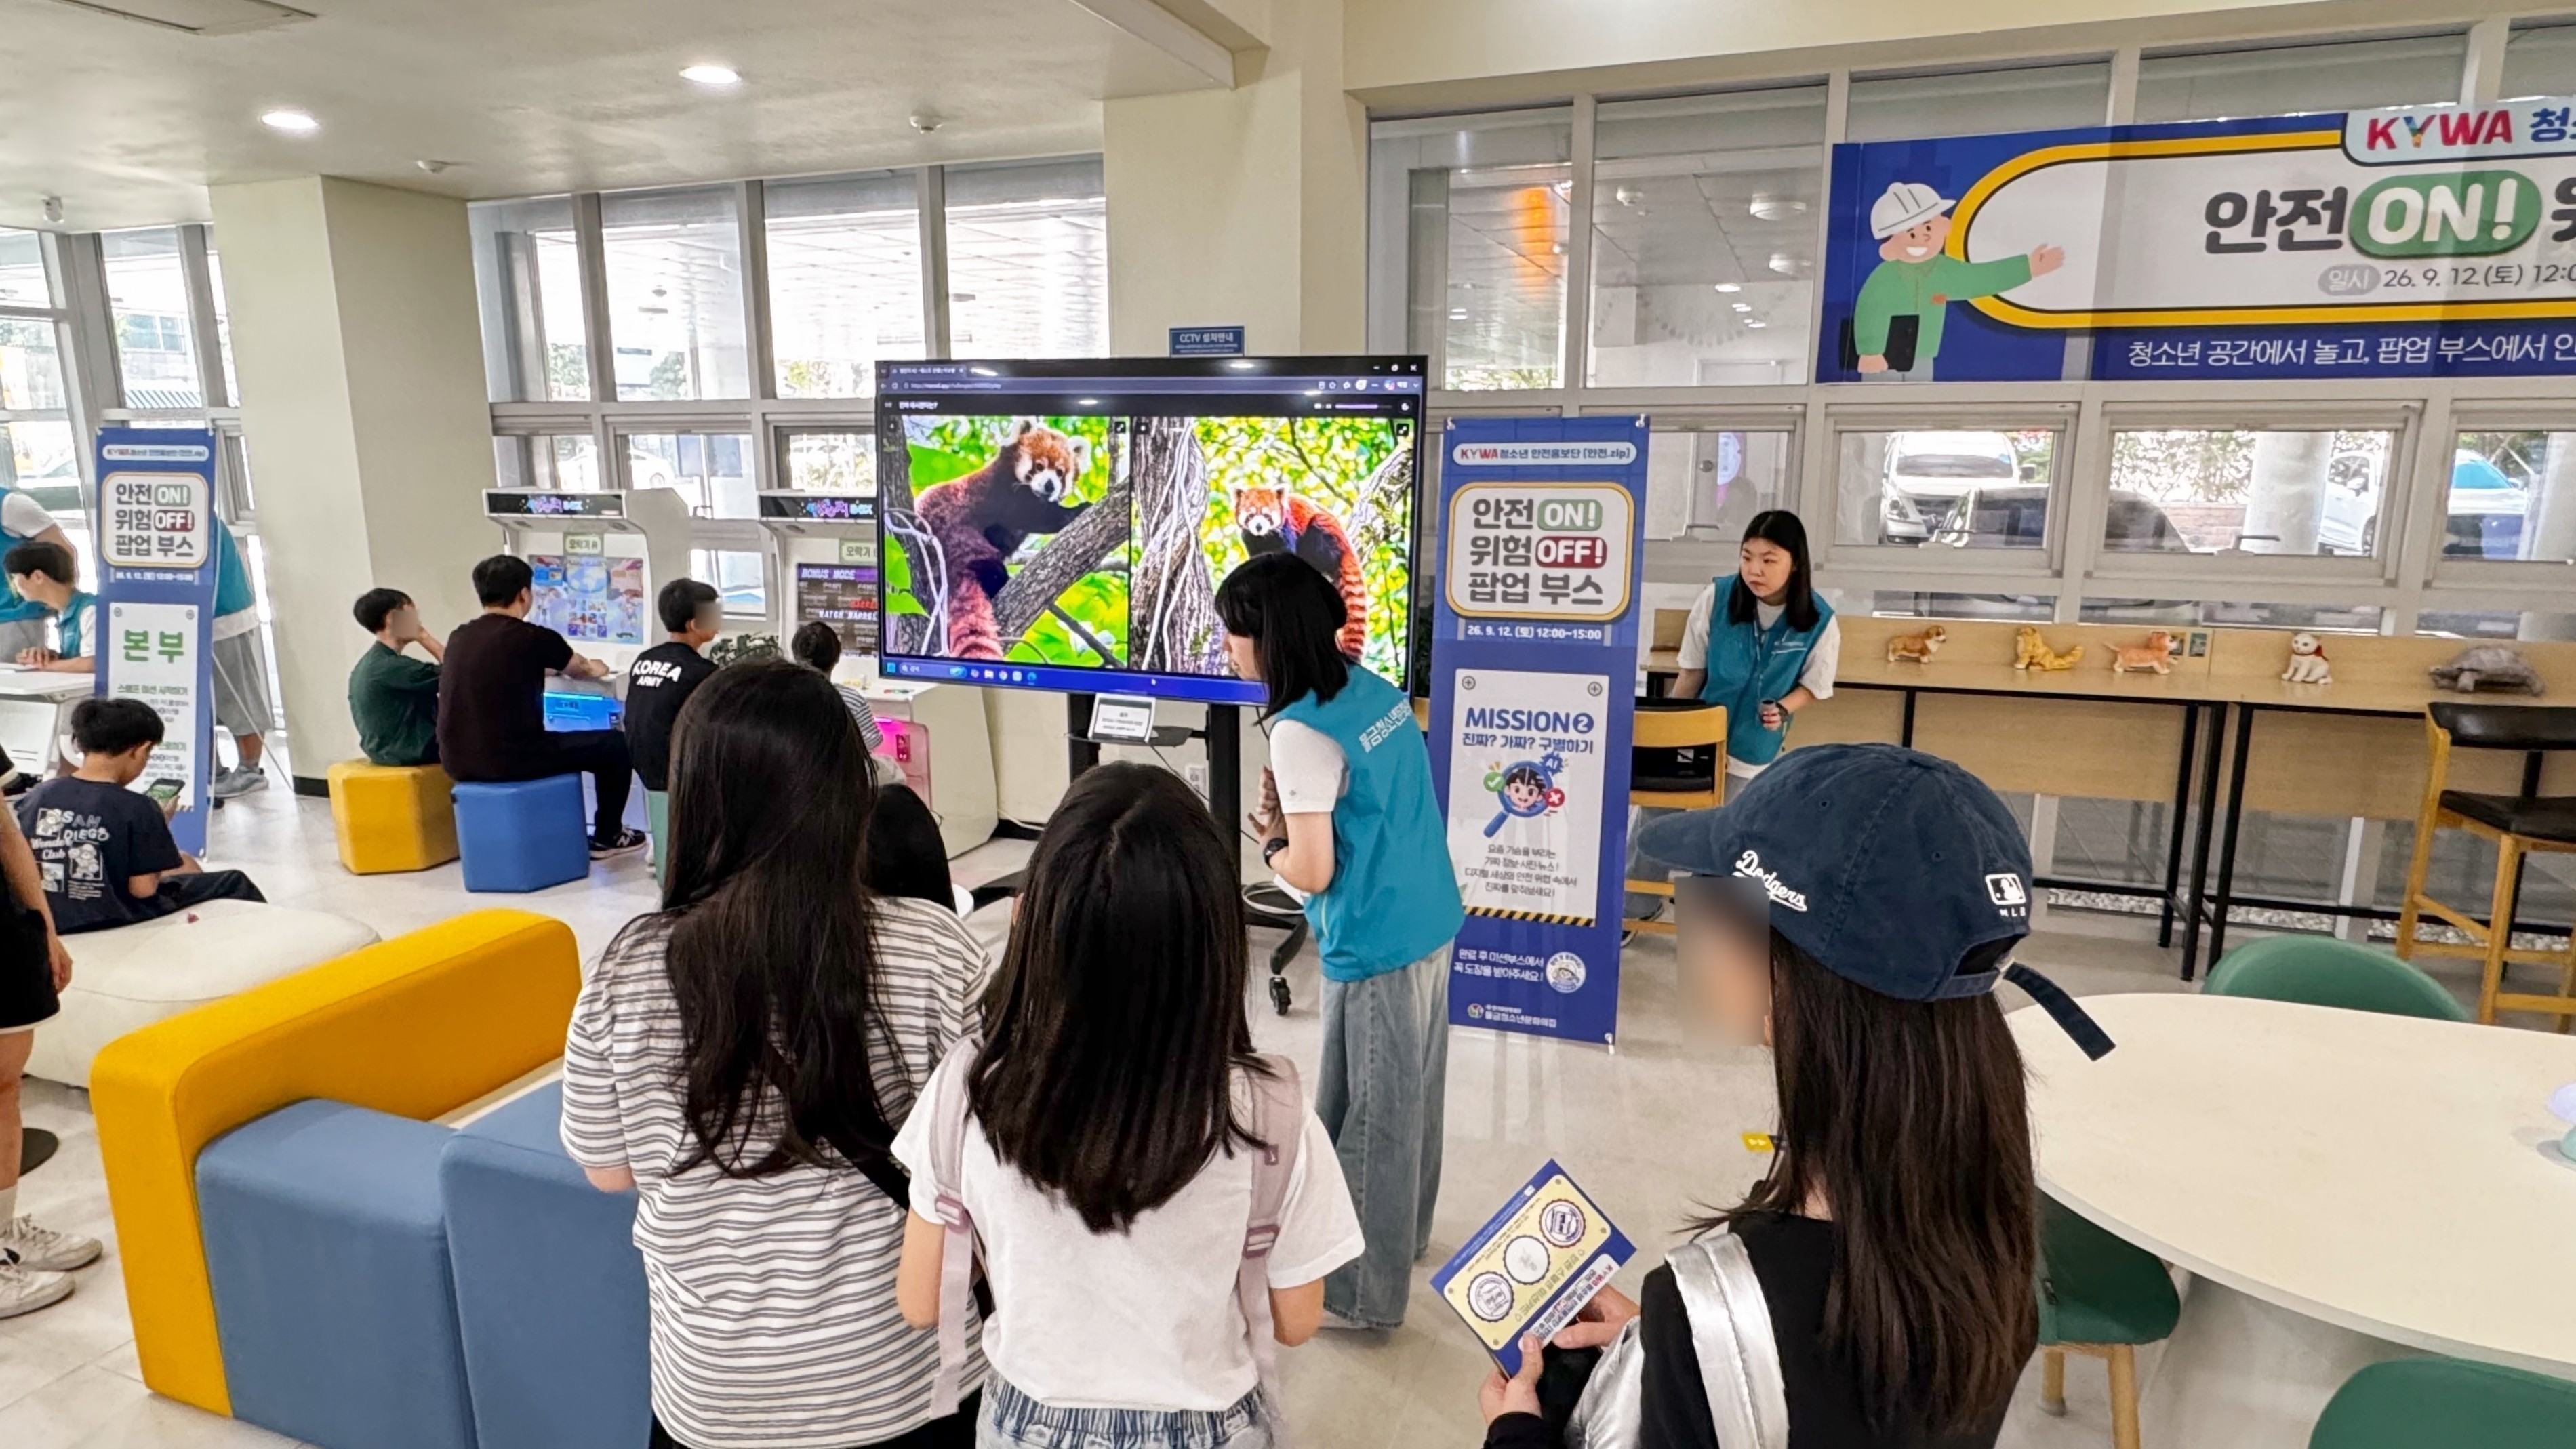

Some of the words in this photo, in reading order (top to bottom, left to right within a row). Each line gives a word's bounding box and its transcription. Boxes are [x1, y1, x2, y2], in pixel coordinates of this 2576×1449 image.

[2366, 110, 2513, 151] KYWA
[2529, 107, 2576, 143] 청
[2205, 186, 2348, 254] 안전
[2367, 178, 2518, 245] ON!
[2328, 270, 2369, 291] 일시
[2383, 270, 2416, 287] 26.
[2423, 268, 2440, 287] 9.
[1180, 333, 1201, 343] CCTV
[1203, 332, 1234, 343] 설치안내
[2128, 341, 2200, 367] 청소년
[2207, 340, 2306, 367] 공간에서
[2312, 339, 2370, 366] 놀고,
[2377, 336, 2432, 364] 팝업
[2436, 333, 2548, 362] 부스에서
[1460, 449, 1498, 460] KYWA
[116, 483, 153, 506] 안전
[157, 487, 188, 504] ON!
[115, 509, 152, 531] 위험
[155, 512, 193, 529] OFF!
[1472, 498, 1534, 529] 안전
[1544, 502, 1596, 527] ON!
[115, 535, 151, 556] 팝업
[157, 535, 194, 557] 부스
[846, 546, 870, 558] 오락기
[1470, 535, 1532, 567] 위험
[1537, 539, 1603, 564] OFF!
[1469, 572, 1530, 603] 팝업
[1539, 574, 1603, 605] 부스
[1468, 625, 1483, 636] 26.
[1486, 626, 1495, 636] 9.
[1498, 626, 1513, 637] 12.
[1537, 628, 1602, 640] 12:00~15:00
[632, 659, 682, 682] KOREA
[636, 676, 664, 687] ARMY
[1465, 707, 1571, 734] MISSION
[1462, 733, 1497, 747] 진짜?
[1500, 735, 1535, 750] 가짜?
[1539, 739, 1594, 754] 구별하기
[1546, 757, 1558, 770] AI
[1732, 849, 1807, 912] Dodgers
